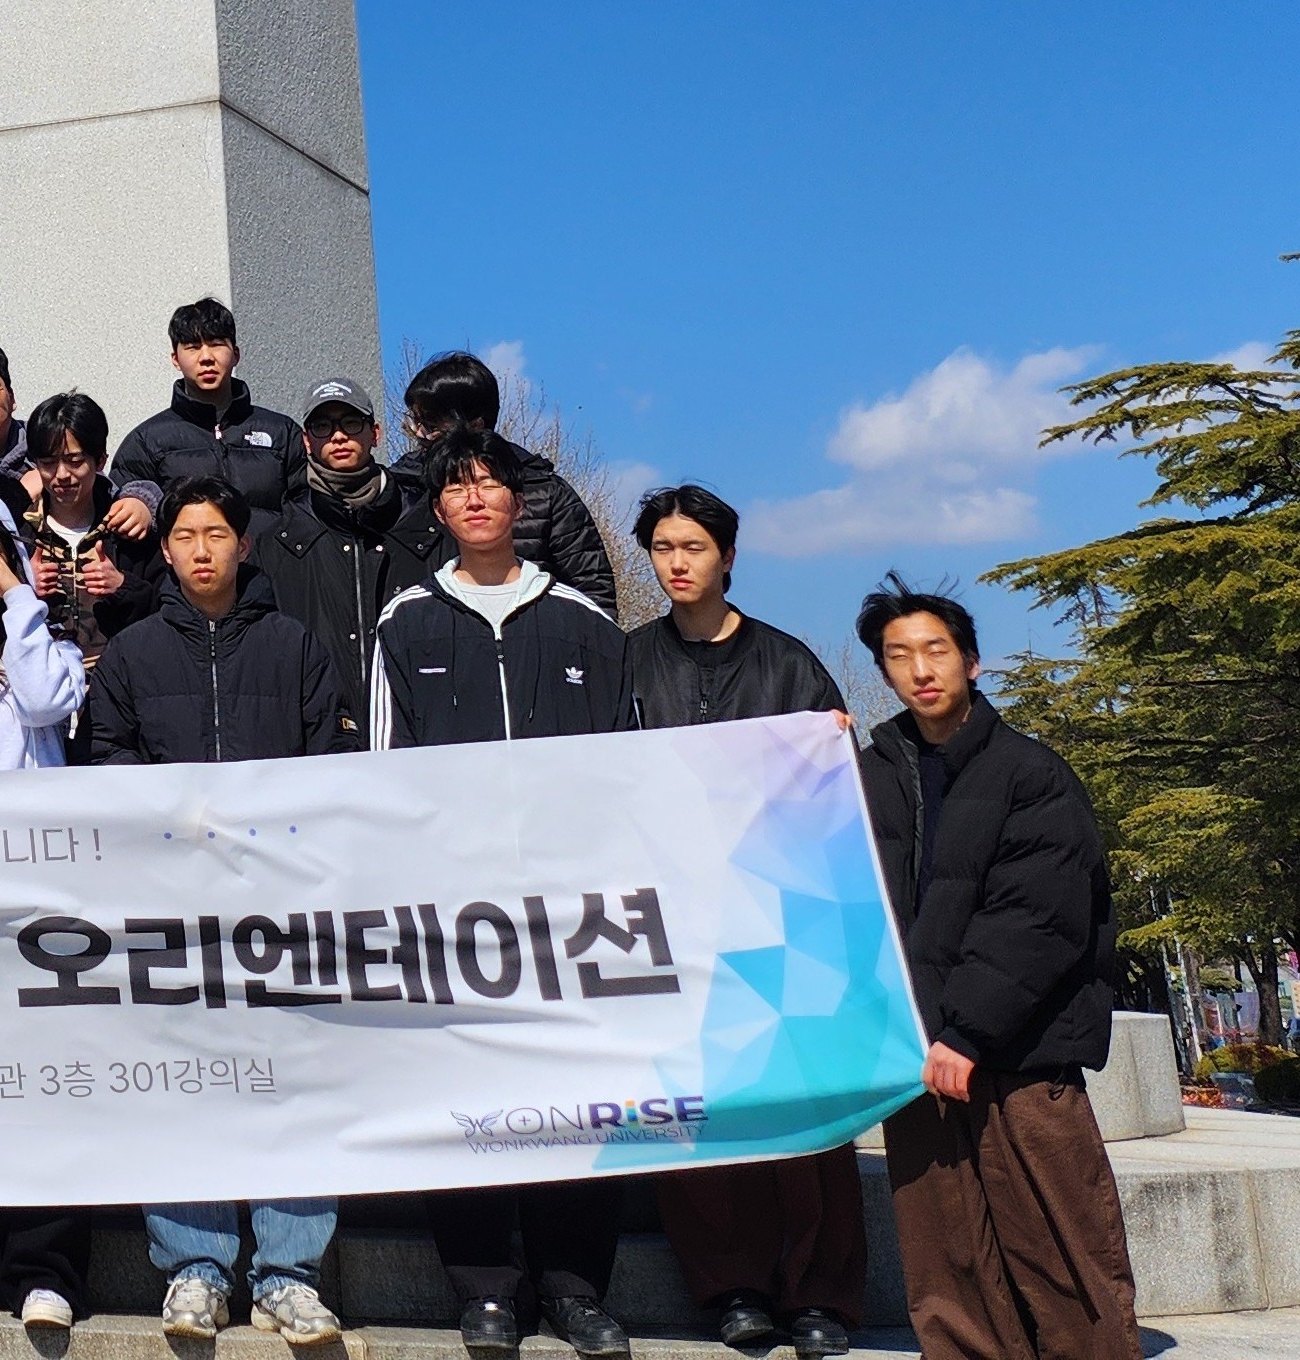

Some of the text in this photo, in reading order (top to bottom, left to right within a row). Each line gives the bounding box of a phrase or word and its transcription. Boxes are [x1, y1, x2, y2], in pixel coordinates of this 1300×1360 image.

[16, 887, 681, 1010] 오리엔테이션
[39, 1063, 96, 1099] 3층
[108, 1056, 278, 1096] 301강의실
[468, 1123, 705, 1155] WONKWANG UNIVERSITY
